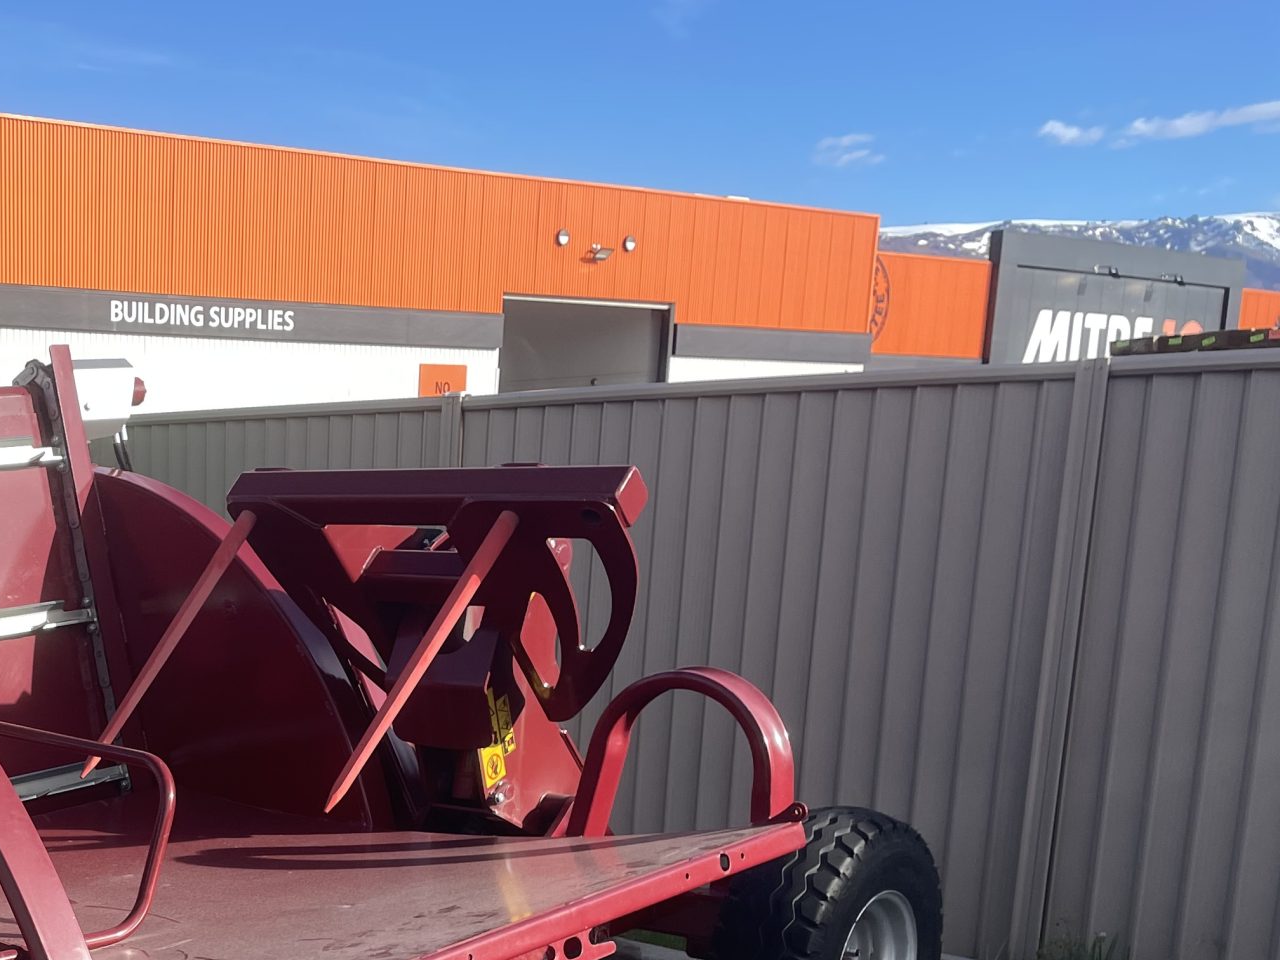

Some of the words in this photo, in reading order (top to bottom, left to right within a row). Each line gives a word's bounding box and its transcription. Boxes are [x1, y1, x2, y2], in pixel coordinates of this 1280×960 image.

[109, 299, 205, 327] BUILDING
[208, 305, 296, 332] SUPPLIES
[434, 380, 451, 395] NO
